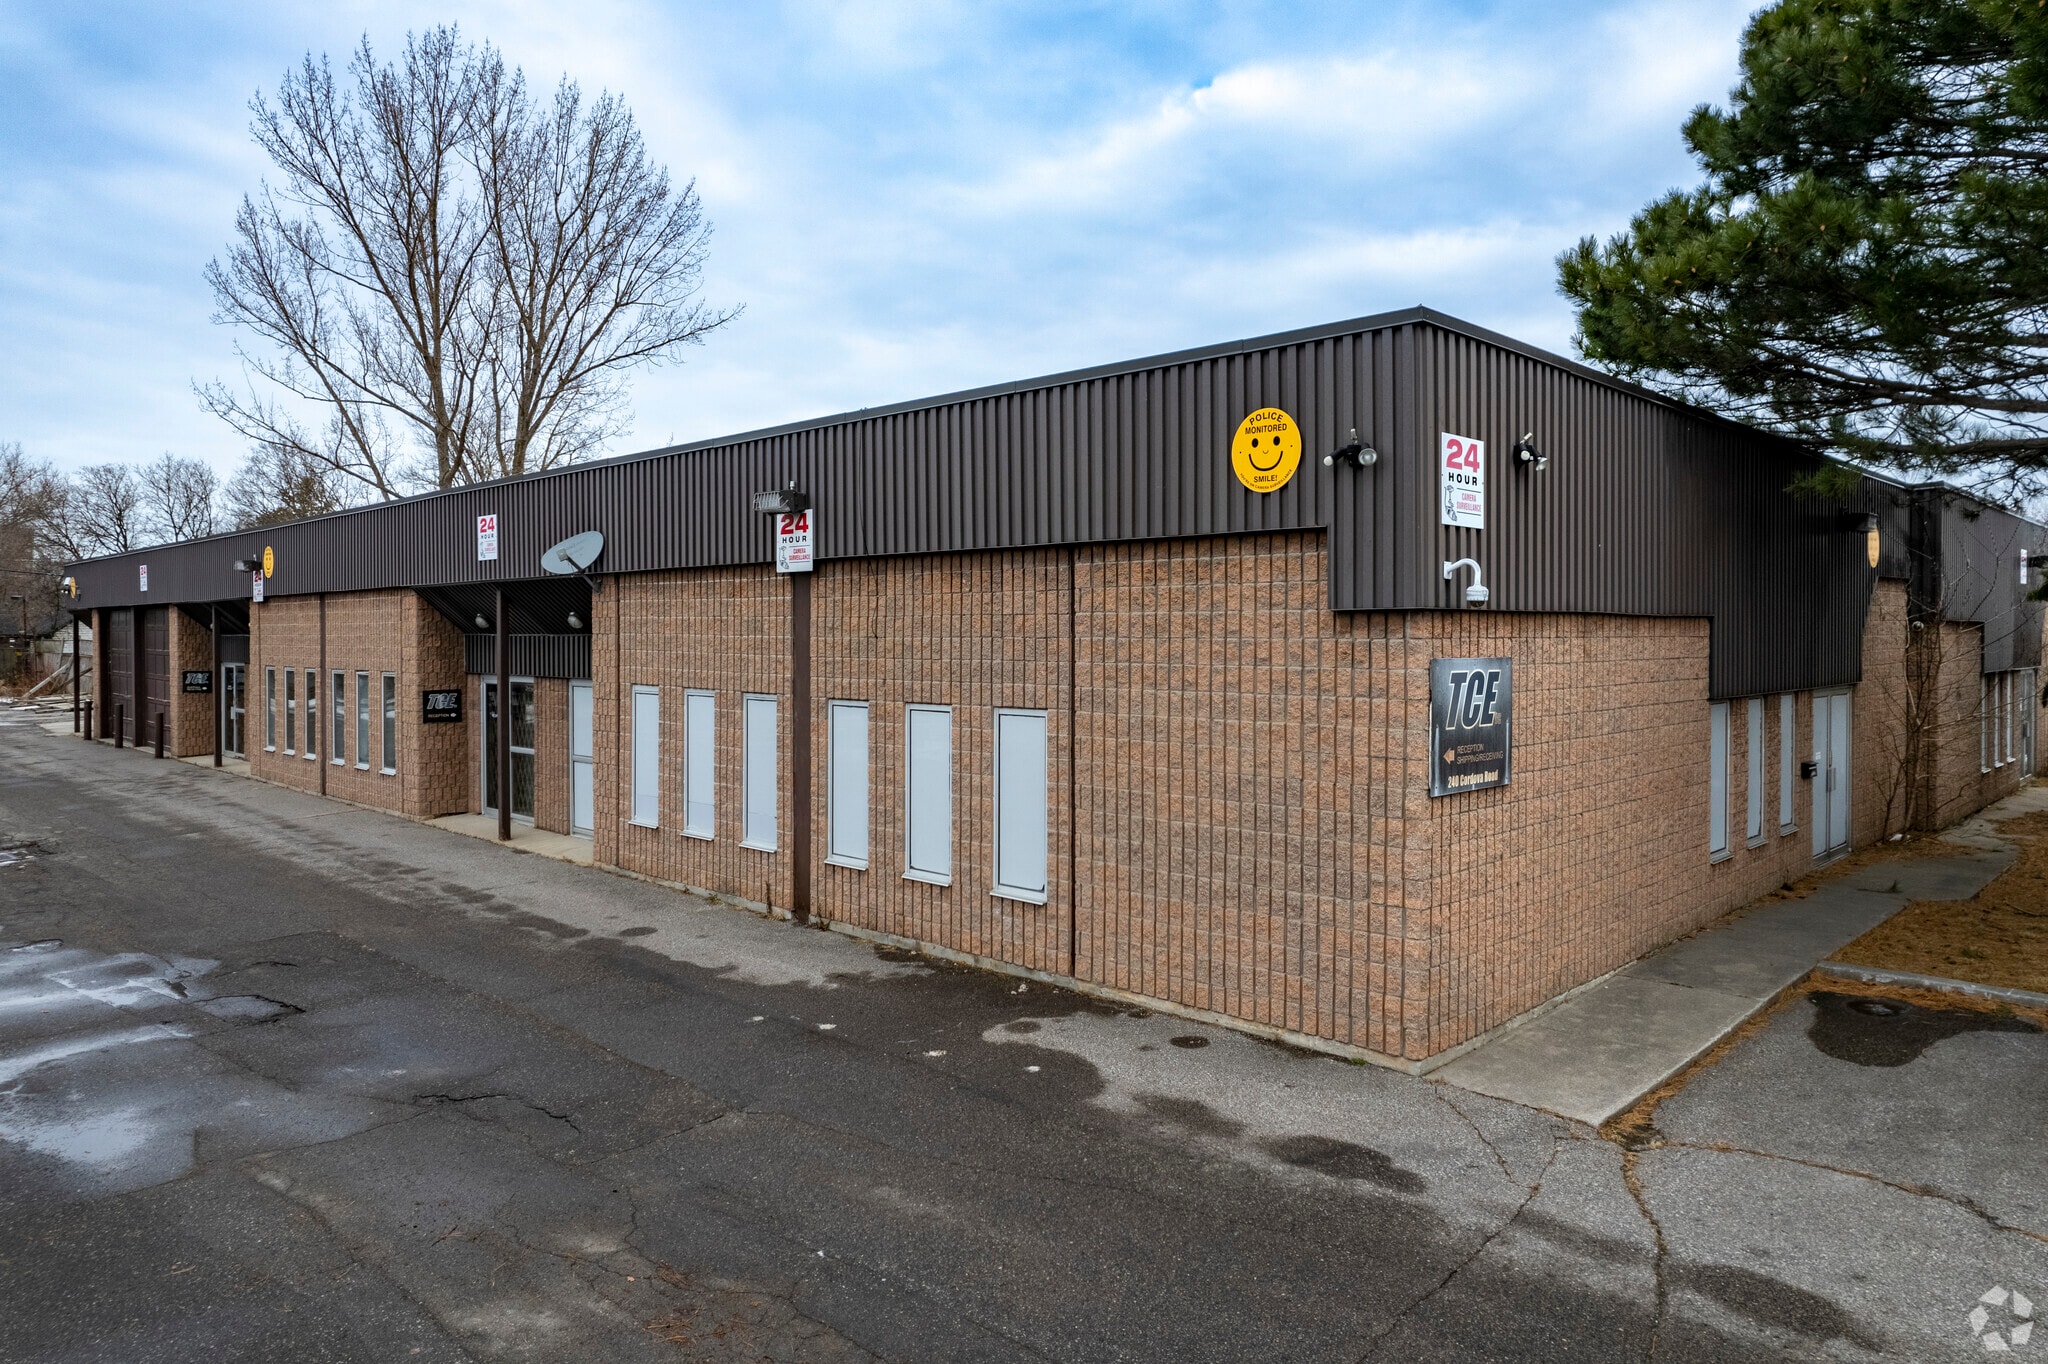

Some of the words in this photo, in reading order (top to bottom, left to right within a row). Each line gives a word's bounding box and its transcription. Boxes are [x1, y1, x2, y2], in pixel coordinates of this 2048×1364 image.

[1249, 412, 1283, 425] POLICE
[1245, 423, 1287, 434] MONITORED
[1446, 438, 1480, 473] 24
[1253, 475, 1278, 483] SMILE!
[1448, 472, 1478, 486] HOUR
[1461, 493, 1477, 502] CAMERA
[1456, 501, 1482, 513] SURVEILLANCE
[480, 517, 495, 533] 24
[780, 512, 809, 535] 24
[782, 535, 807, 544] HOUR
[254, 570, 262, 583] 24
[426, 693, 458, 710] TCE
[1445, 669, 1501, 730] TCE
[1456, 744, 1485, 754] RECEPTION
[1456, 751, 1504, 764] SHIPPING/RECEIVING
[1447, 775, 1460, 788] 240
[1460, 773, 1484, 786] Cordova
[1484, 769, 1499, 782] Road
